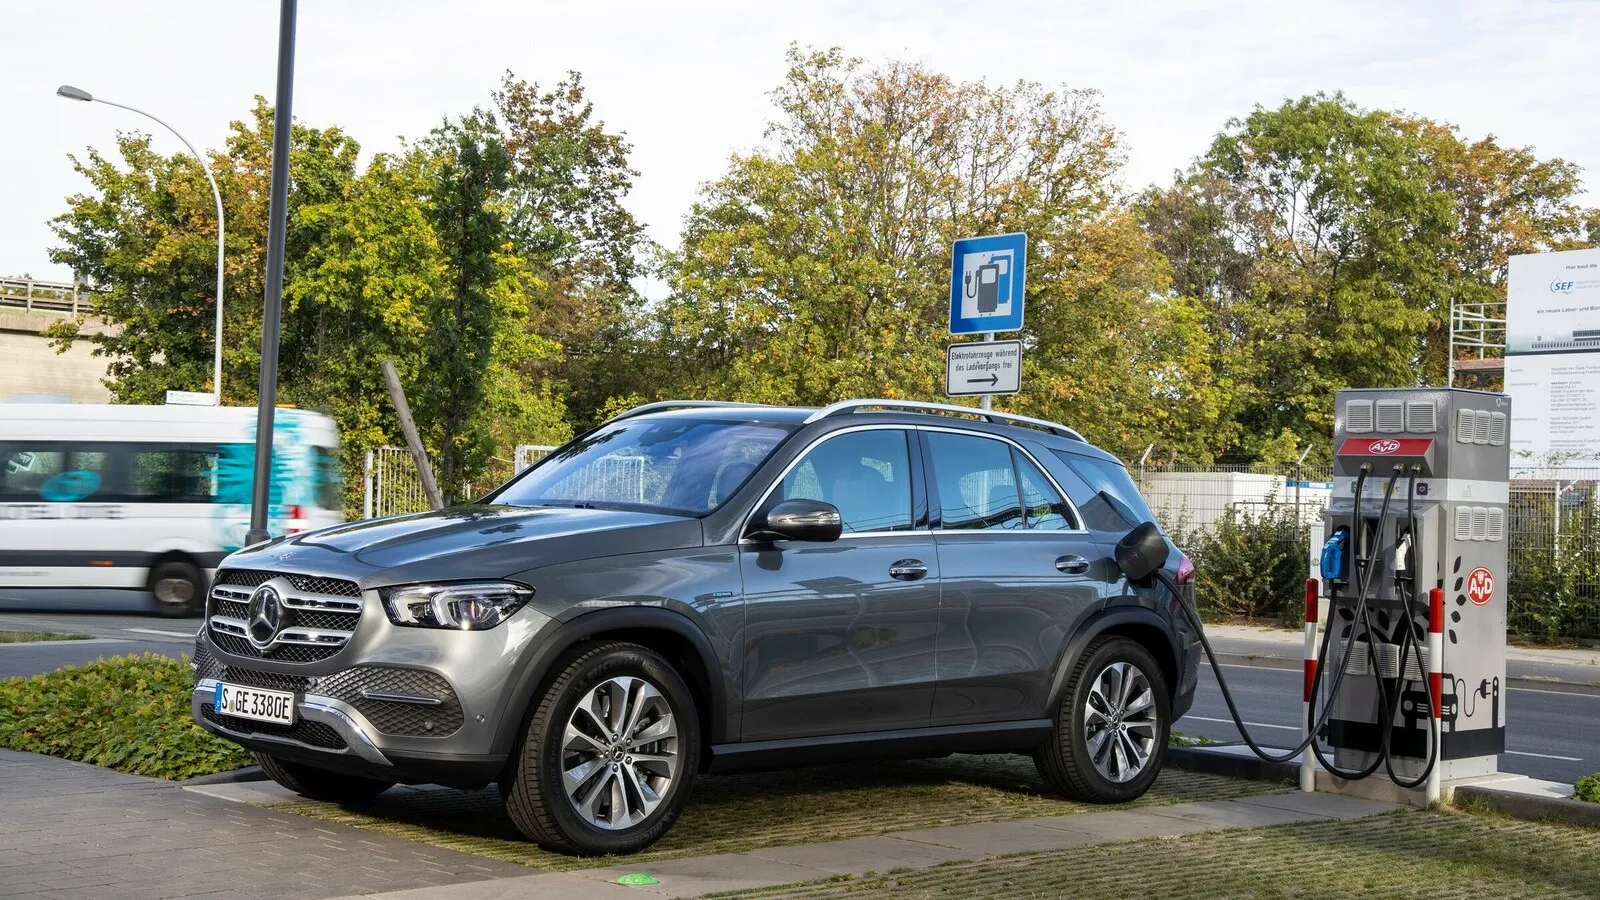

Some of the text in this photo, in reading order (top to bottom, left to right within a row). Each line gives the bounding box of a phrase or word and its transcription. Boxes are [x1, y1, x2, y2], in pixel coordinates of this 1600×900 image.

[1554, 281, 1574, 291] SEF
[951, 349, 1017, 360] Elektrofahrzeuge während
[955, 361, 1012, 371] des Ladevorgangs frei
[222, 687, 290, 719] S GE 3380E
